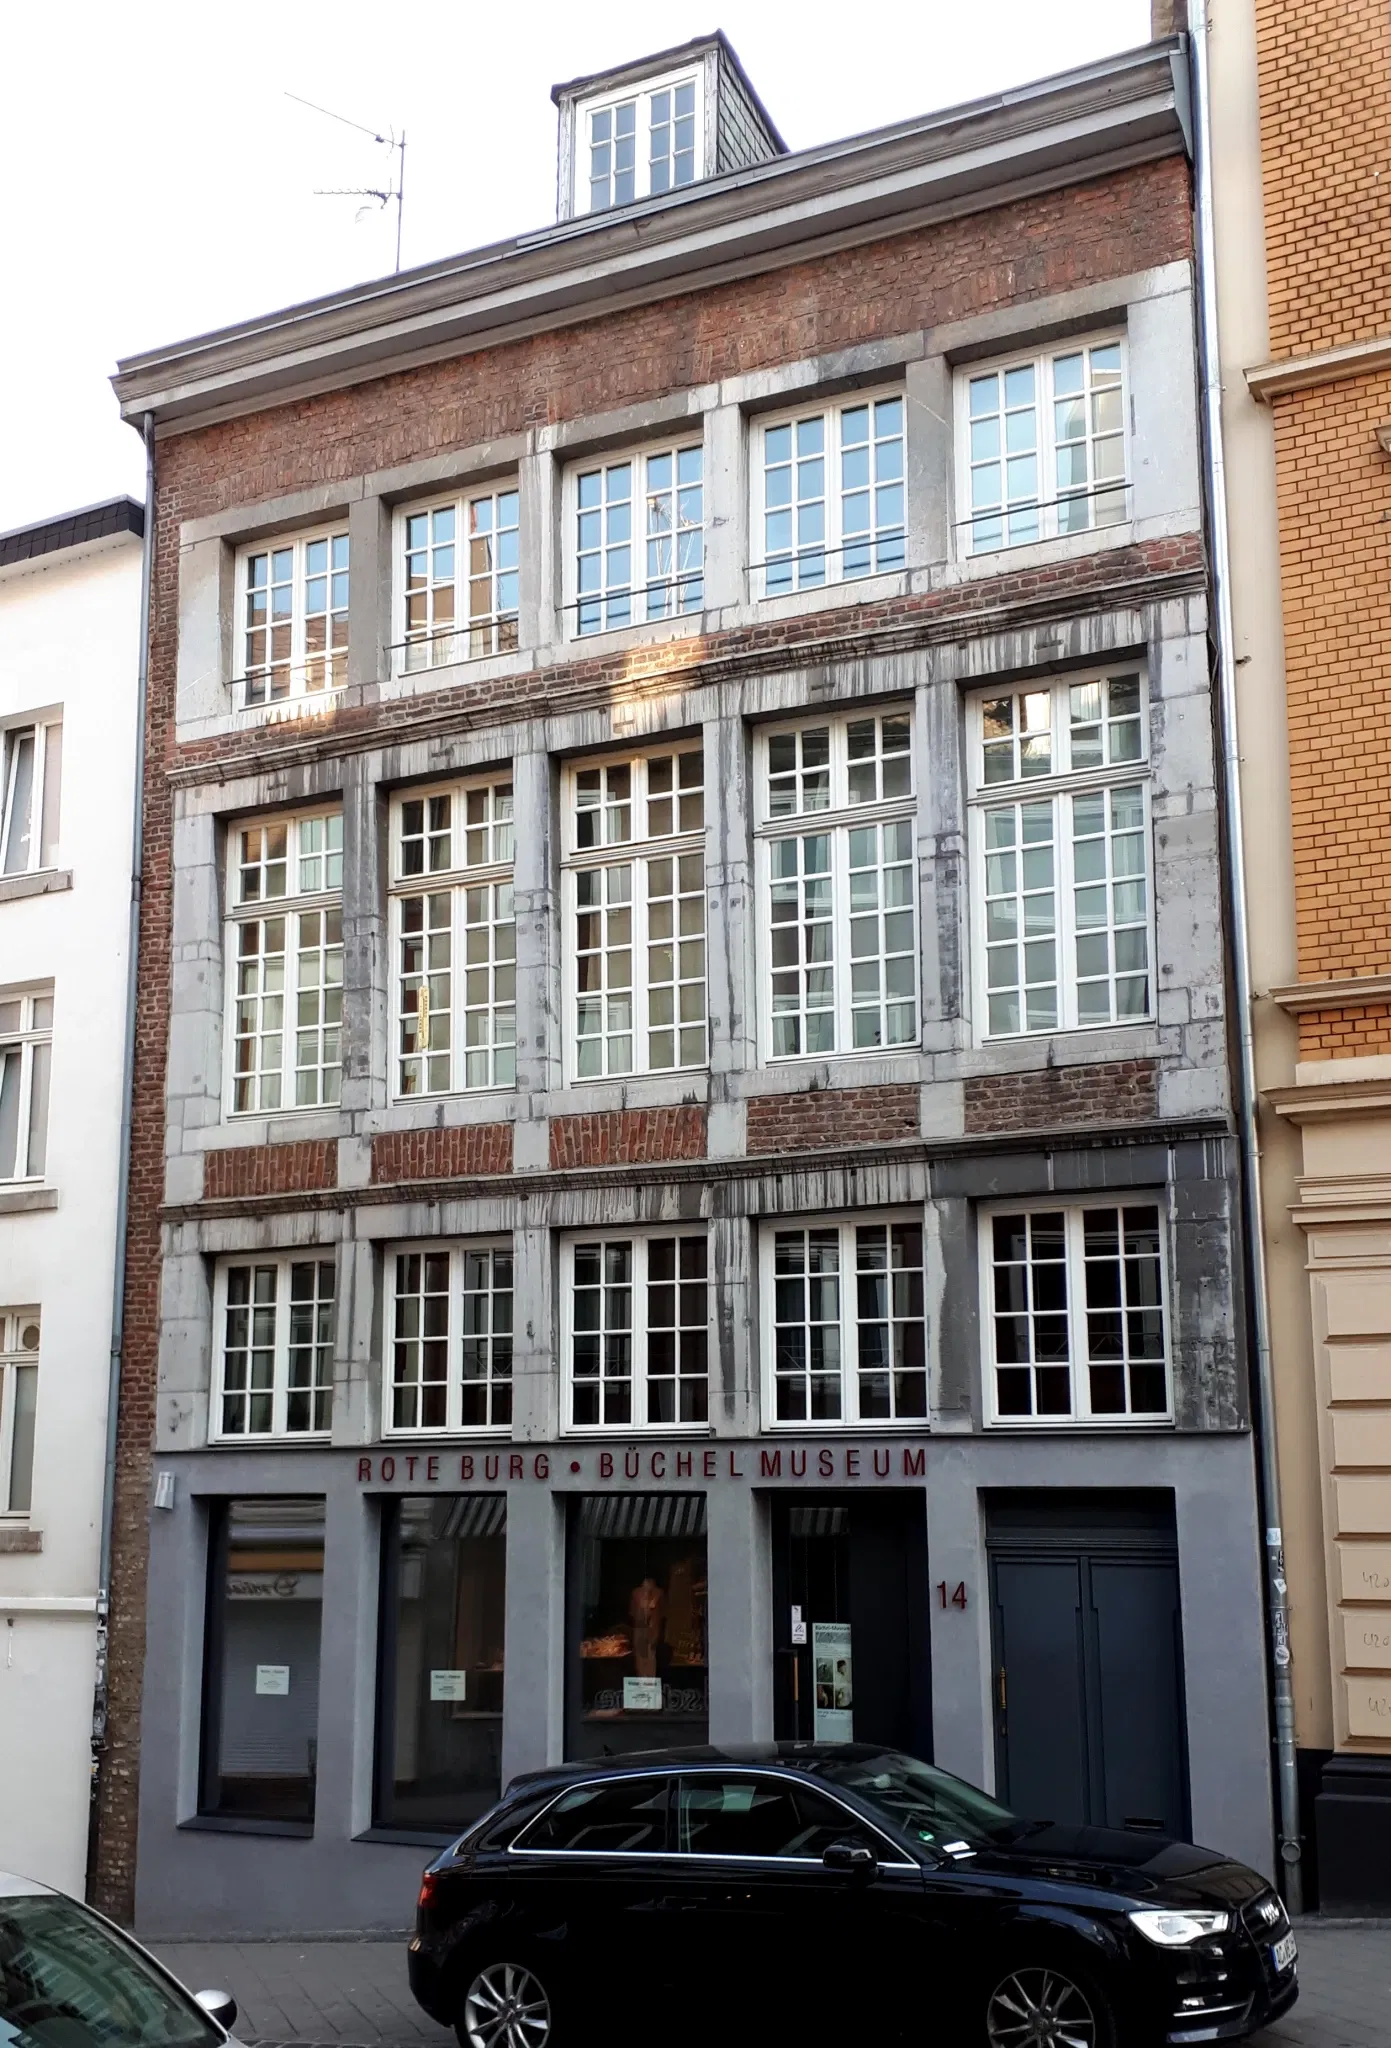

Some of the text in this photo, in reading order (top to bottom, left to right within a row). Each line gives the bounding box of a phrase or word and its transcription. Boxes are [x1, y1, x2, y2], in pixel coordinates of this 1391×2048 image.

[357, 1447, 928, 1482] ROTE BURG BÜCHEL MUSEUM
[936, 1580, 968, 1609] 14
